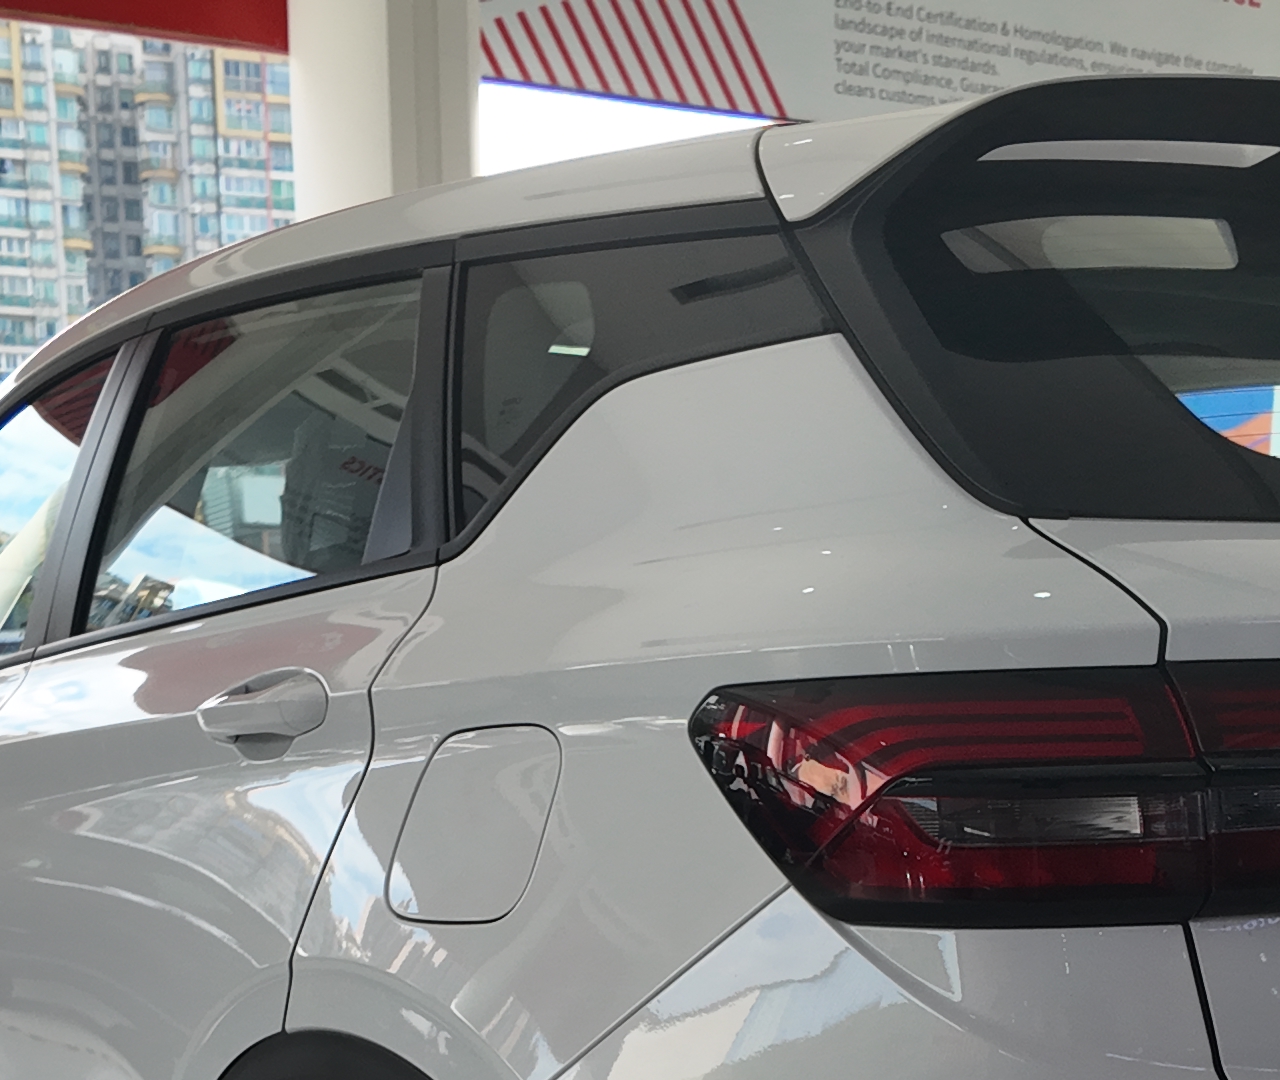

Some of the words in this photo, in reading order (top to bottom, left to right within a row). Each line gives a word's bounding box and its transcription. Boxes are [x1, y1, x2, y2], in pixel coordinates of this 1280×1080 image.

[916, 6, 998, 35] Certification
[1000, 20, 1010, 36] &
[834, 13, 906, 41] landscape
[908, 26, 924, 42] of
[926, 30, 1011, 58] international
[834, 39, 866, 56] your
[835, 57, 869, 76] Total
[834, 79, 875, 99] clears
